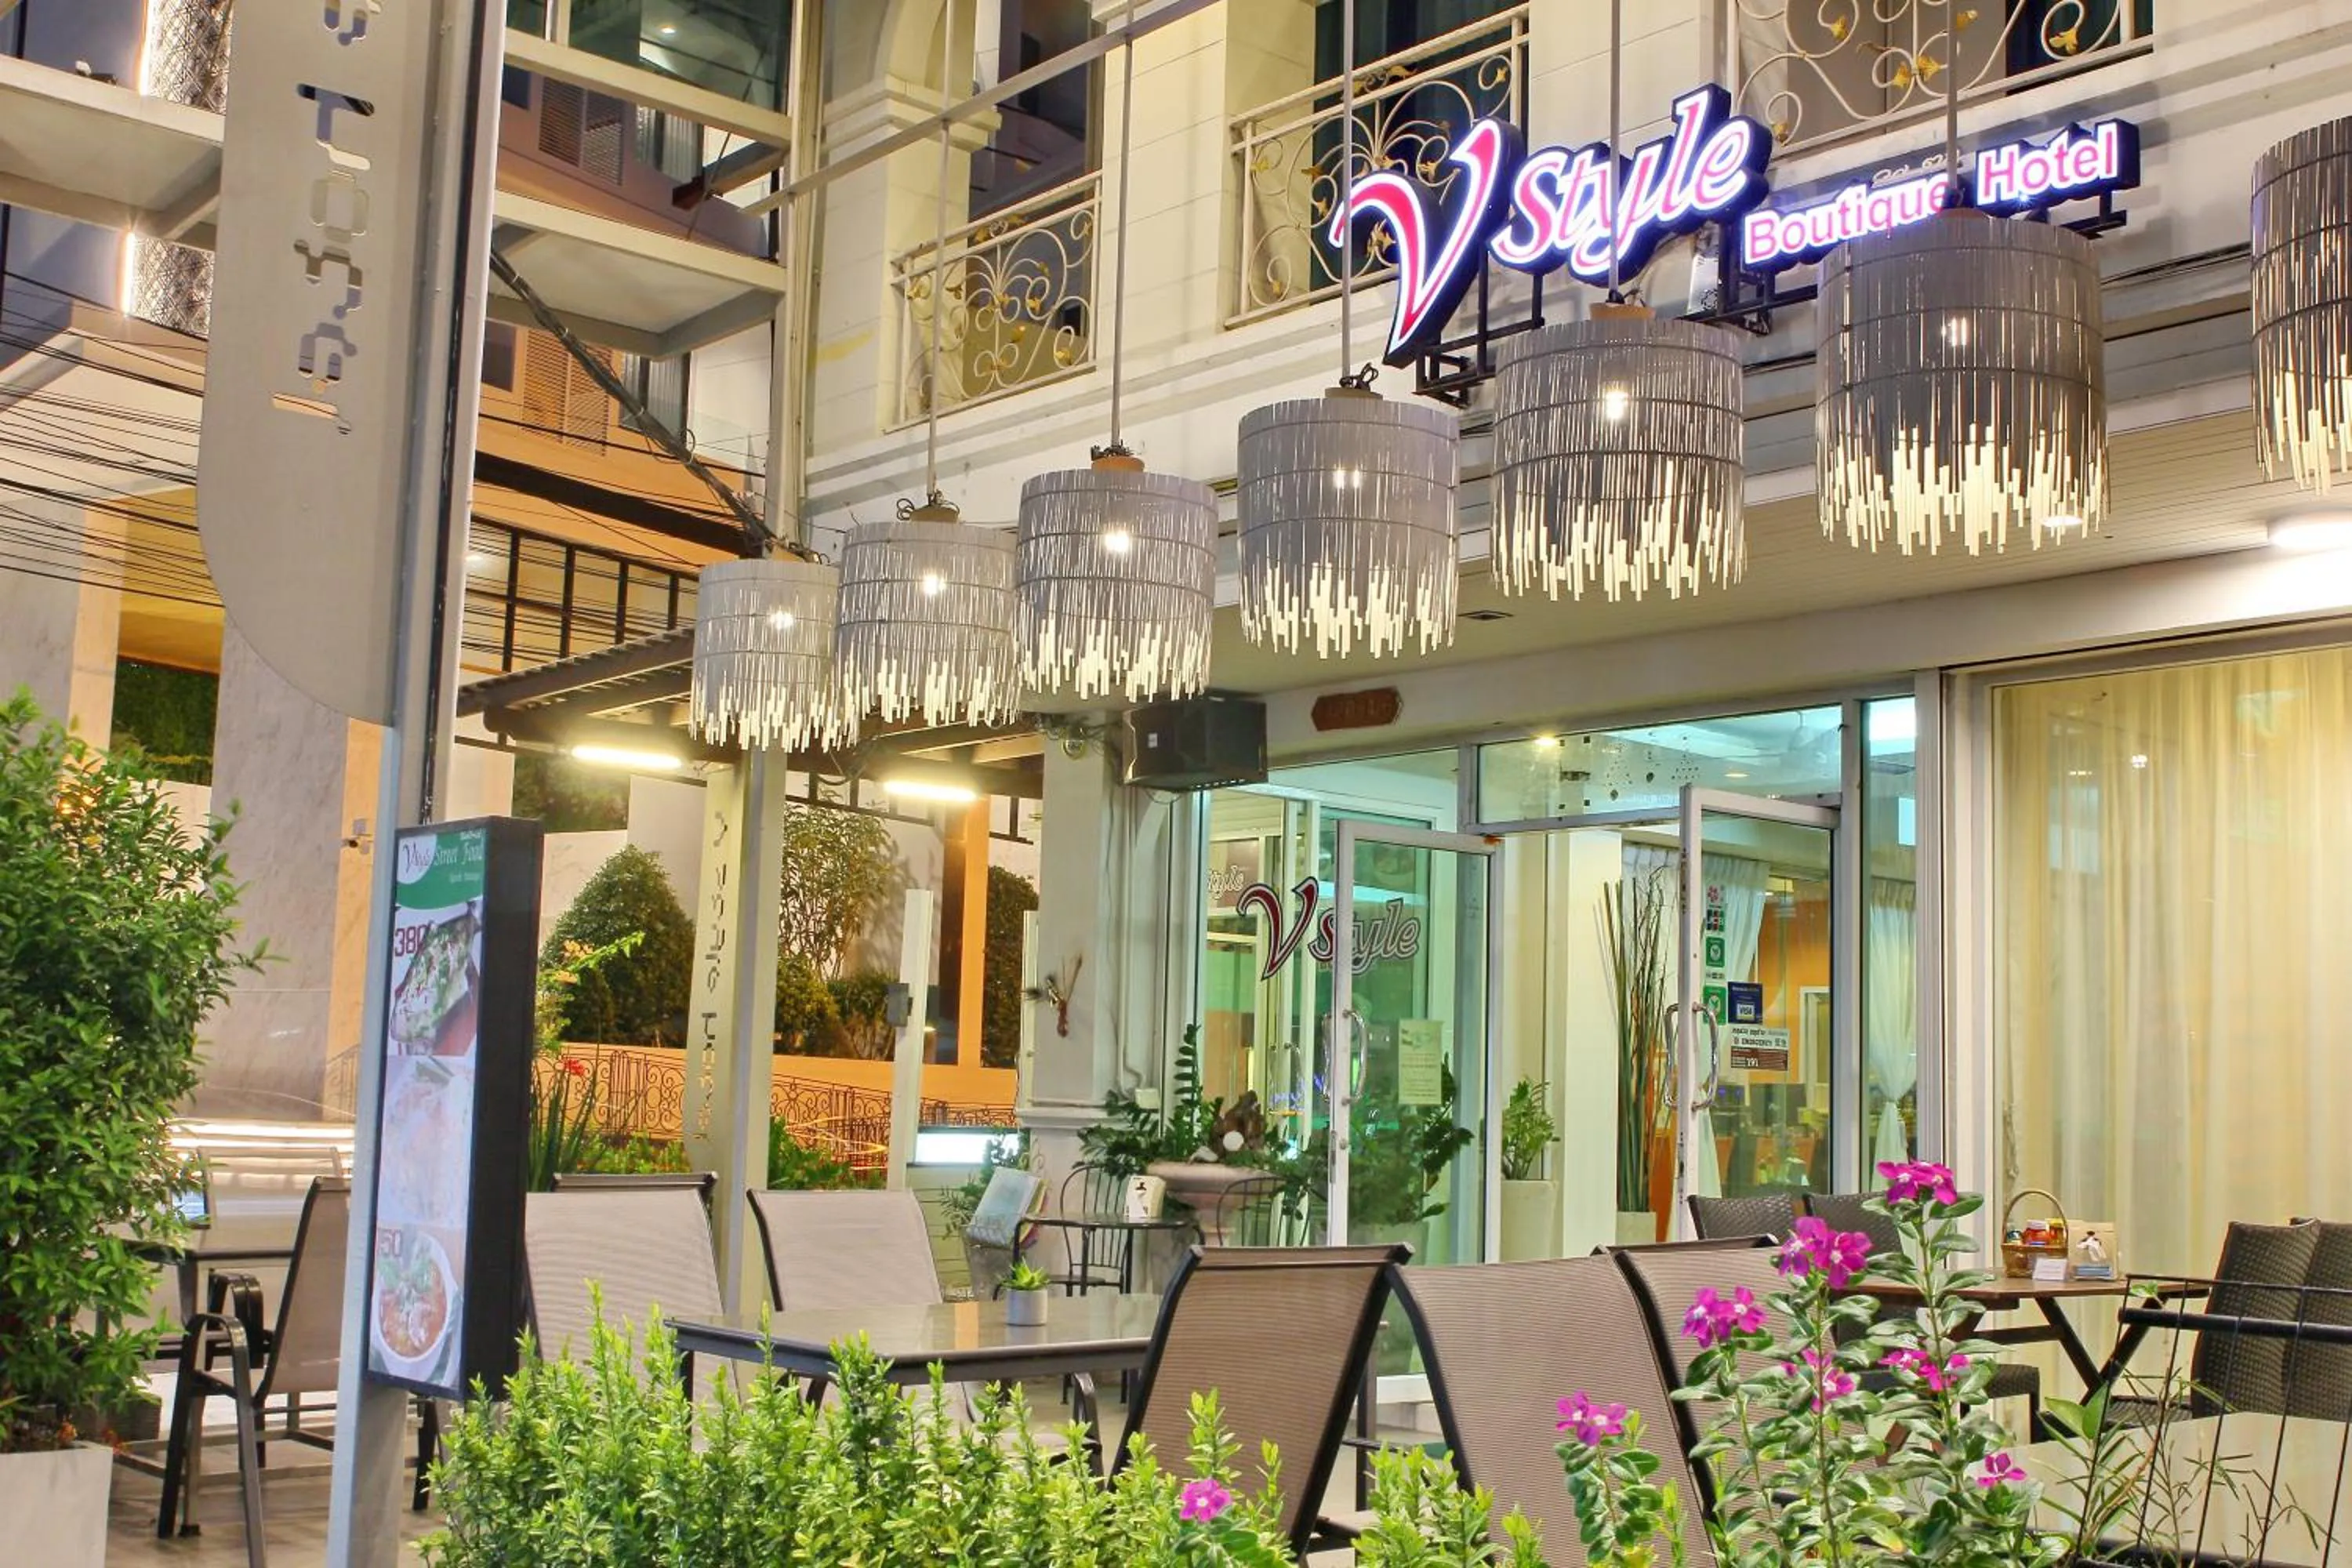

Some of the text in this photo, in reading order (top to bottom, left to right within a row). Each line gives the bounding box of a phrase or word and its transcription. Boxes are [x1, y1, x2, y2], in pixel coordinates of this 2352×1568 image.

[1334, 119, 1501, 350] V
[1741, 179, 1949, 267] Boutique
[1976, 121, 2118, 206] Hotel
[1236, 876, 1319, 981] V
